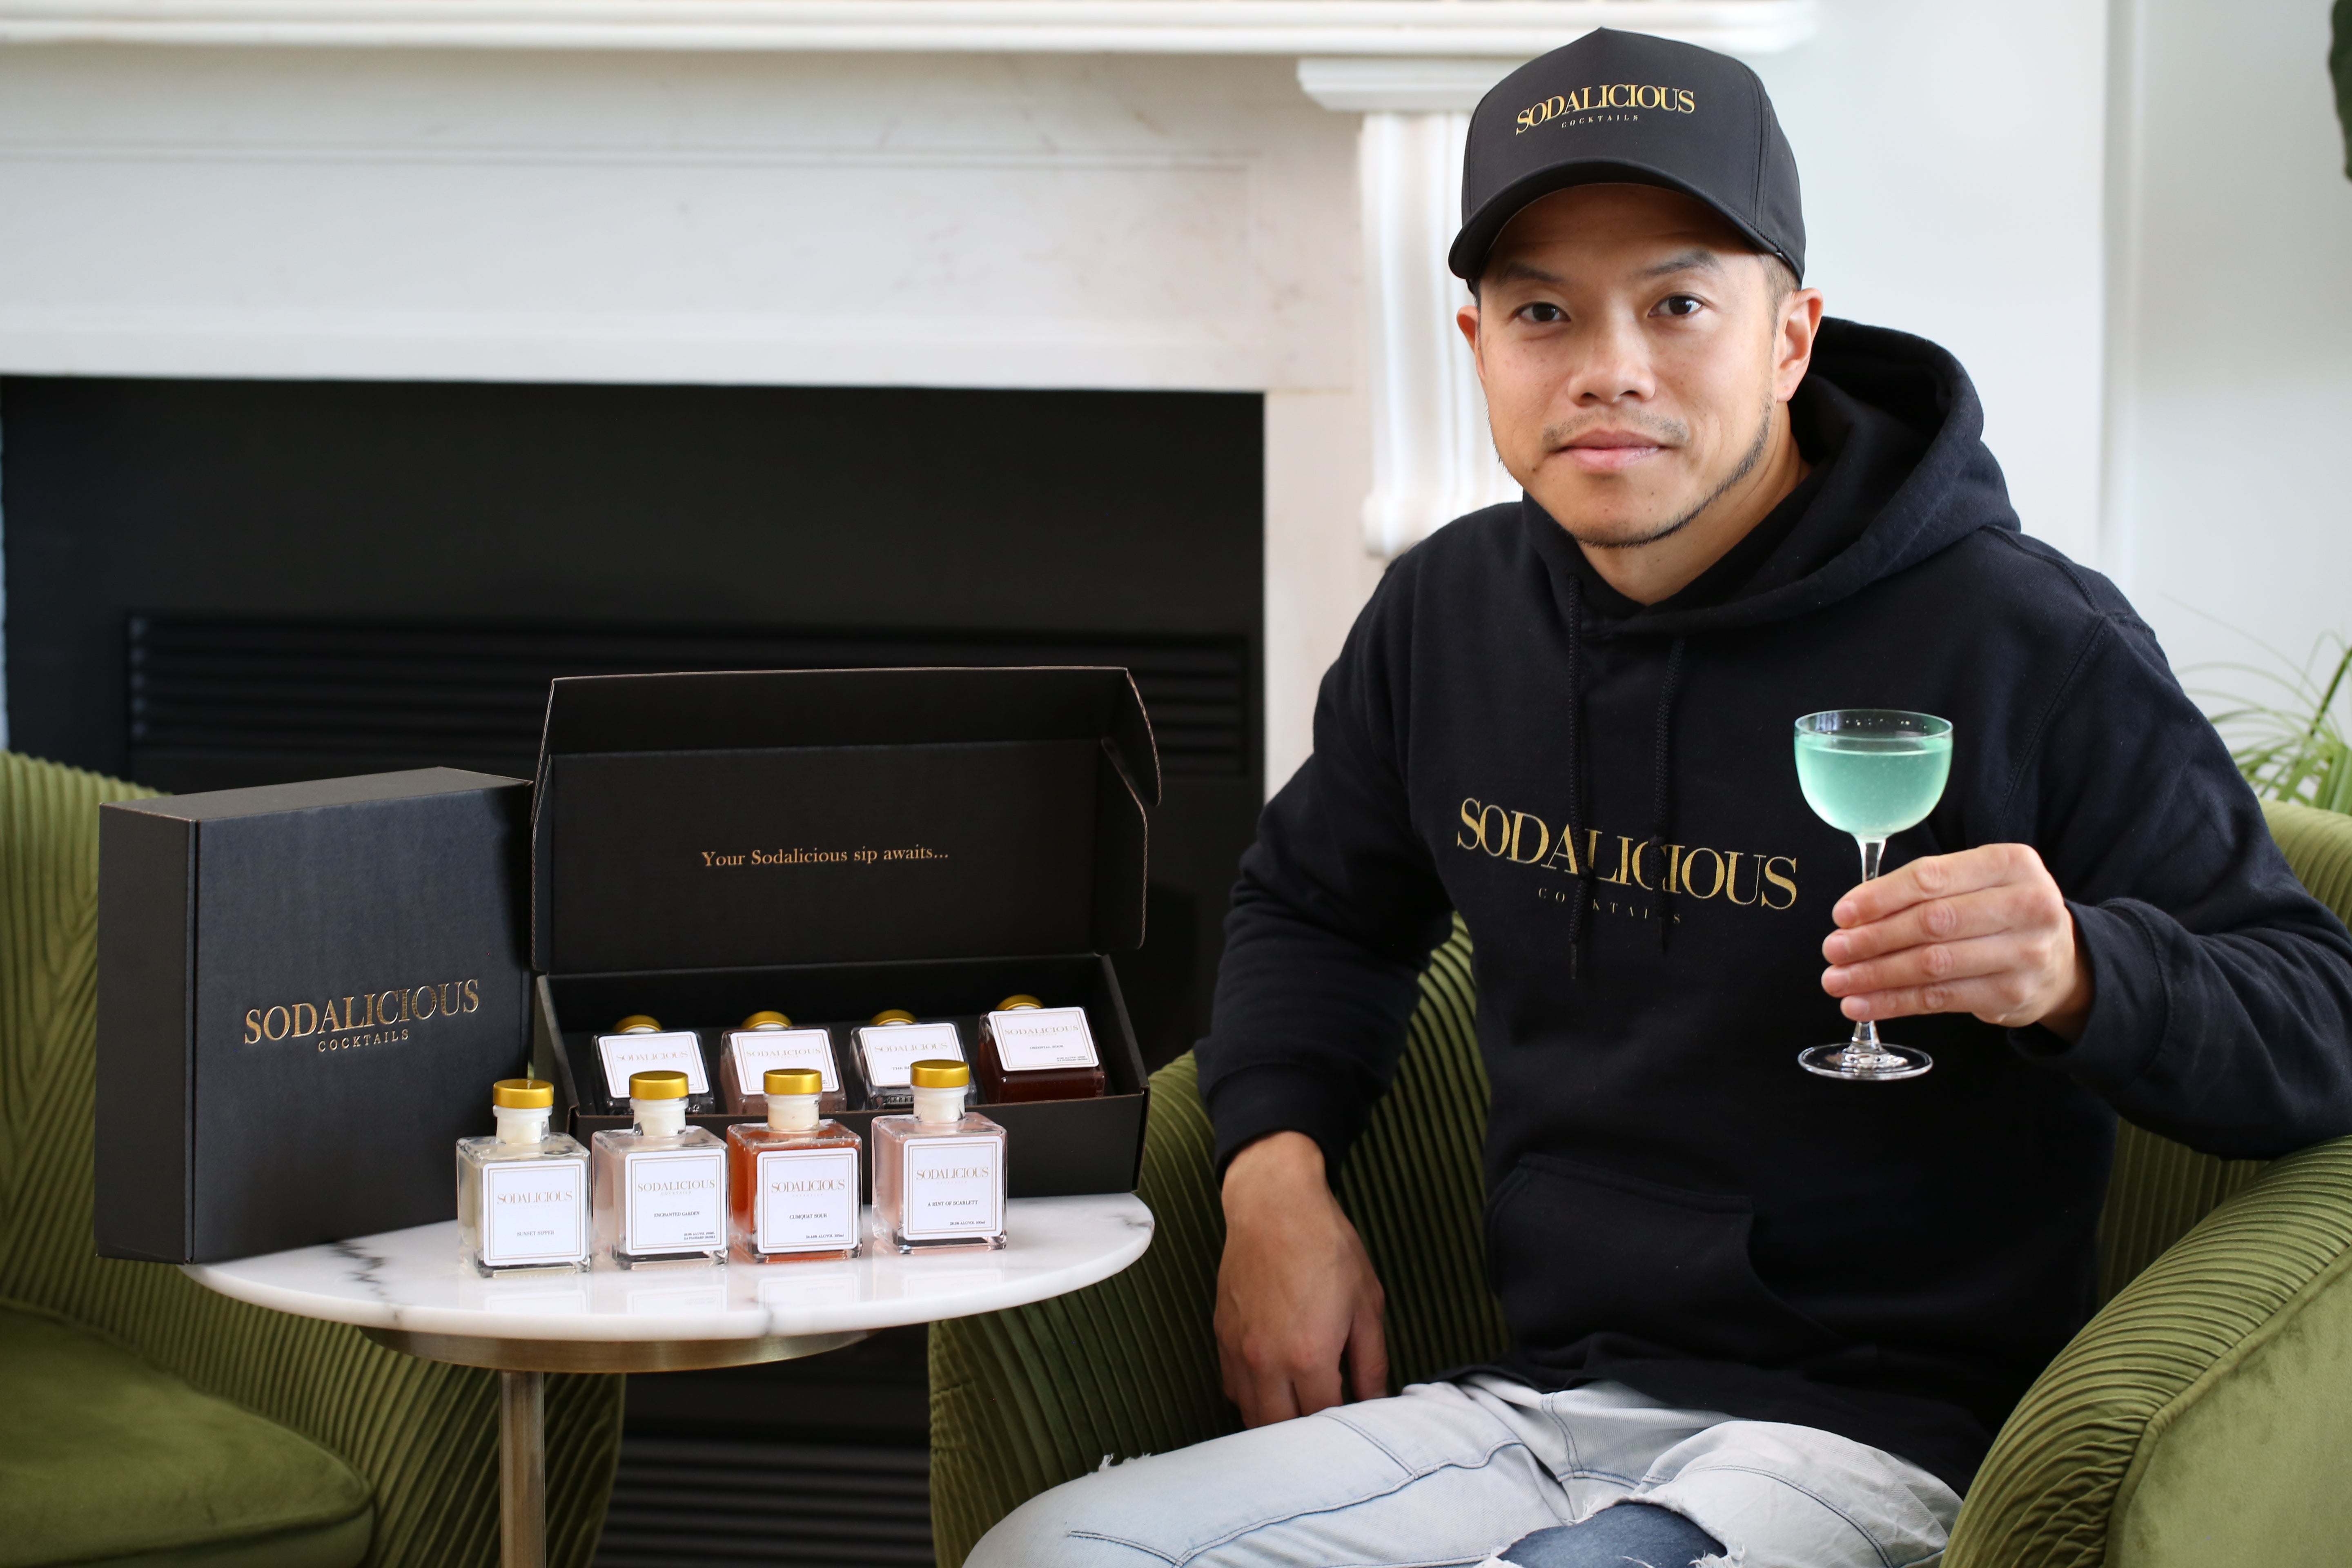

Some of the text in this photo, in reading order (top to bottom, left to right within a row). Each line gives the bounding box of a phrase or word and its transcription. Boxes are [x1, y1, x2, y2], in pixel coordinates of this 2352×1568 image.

[1515, 84, 1696, 136] SODALICIOUS
[1561, 115, 1639, 129] COCKTAILS
[702, 844, 949, 867] Your Sodalicious sip awaits...
[1538, 887, 1681, 924] COKTAIS
[245, 979, 480, 1045] SODALICIOUS
[1004, 1025, 1079, 1035] SODALICIOUS
[318, 1029, 409, 1052] COCKTAILS
[746, 1048, 821, 1057] SODALICIOUS
[916, 1167, 989, 1180] SODALICIOUS
[637, 1180, 715, 1192] SODALICIOUS
[771, 1179, 845, 1193] SODALICIOUS
[497, 1191, 572, 1205] SODALICIOUS
